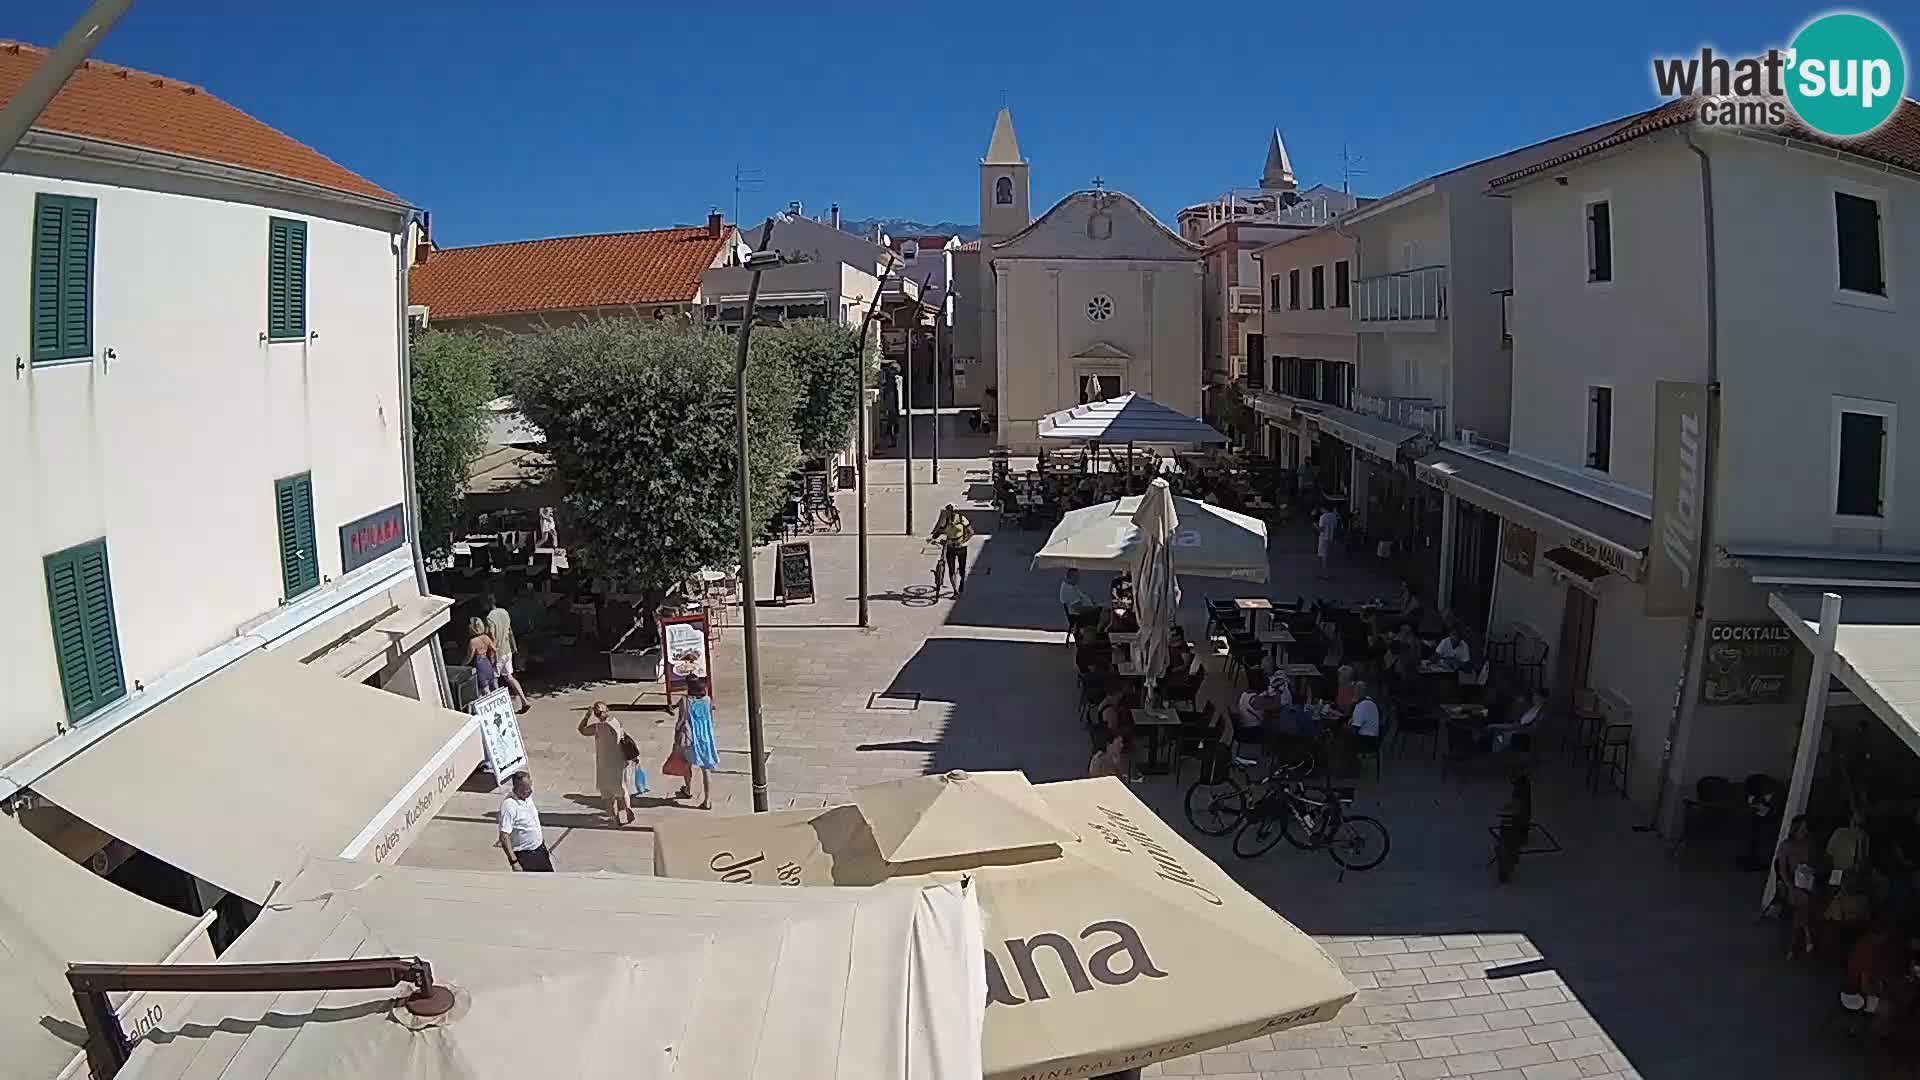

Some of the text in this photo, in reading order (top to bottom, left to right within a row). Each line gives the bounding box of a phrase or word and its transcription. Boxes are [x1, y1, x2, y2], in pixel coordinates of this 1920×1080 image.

[1711, 626, 1791, 640] COCKTAILS
[479, 695, 508, 716] TATTOO
[375, 767, 455, 863] Cakes Kuchen Dolci
[130, 1004, 163, 1041] elato
[1123, 1040, 1194, 1063] WATER
